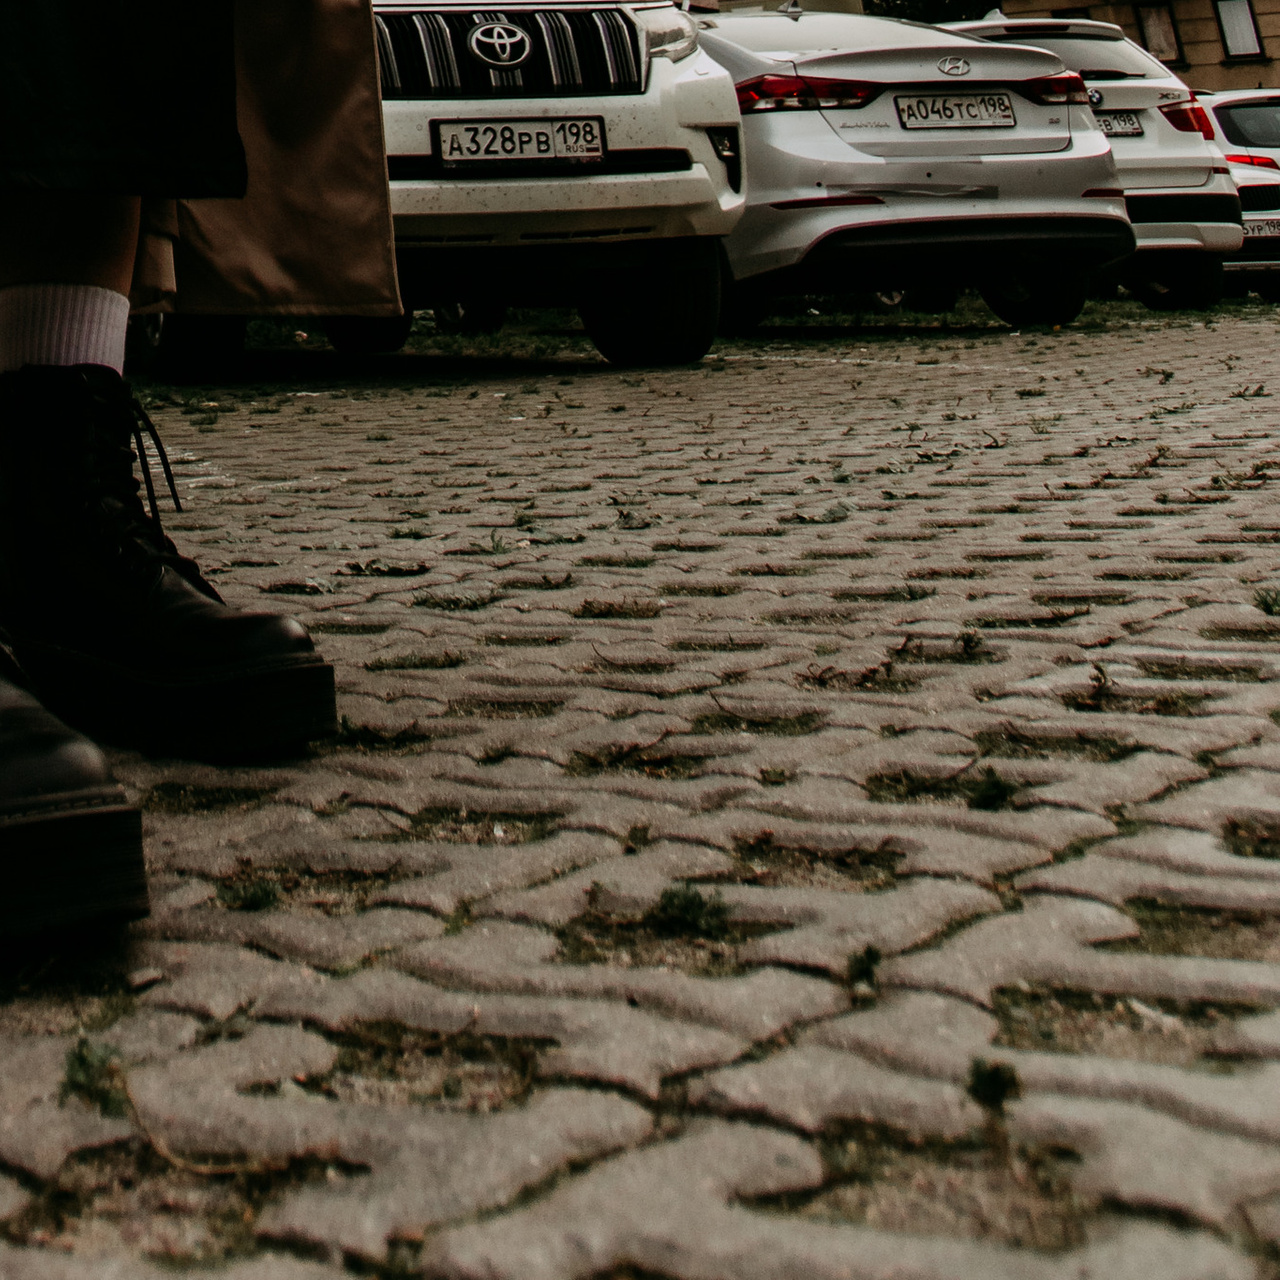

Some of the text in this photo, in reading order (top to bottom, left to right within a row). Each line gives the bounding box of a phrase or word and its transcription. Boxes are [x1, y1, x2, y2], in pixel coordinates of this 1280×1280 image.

[906, 96, 1007, 121] А046ТС 198
[1113, 114, 1135, 126] 198
[448, 122, 595, 156] А328РВ 198
[565, 144, 585, 153] RUS
